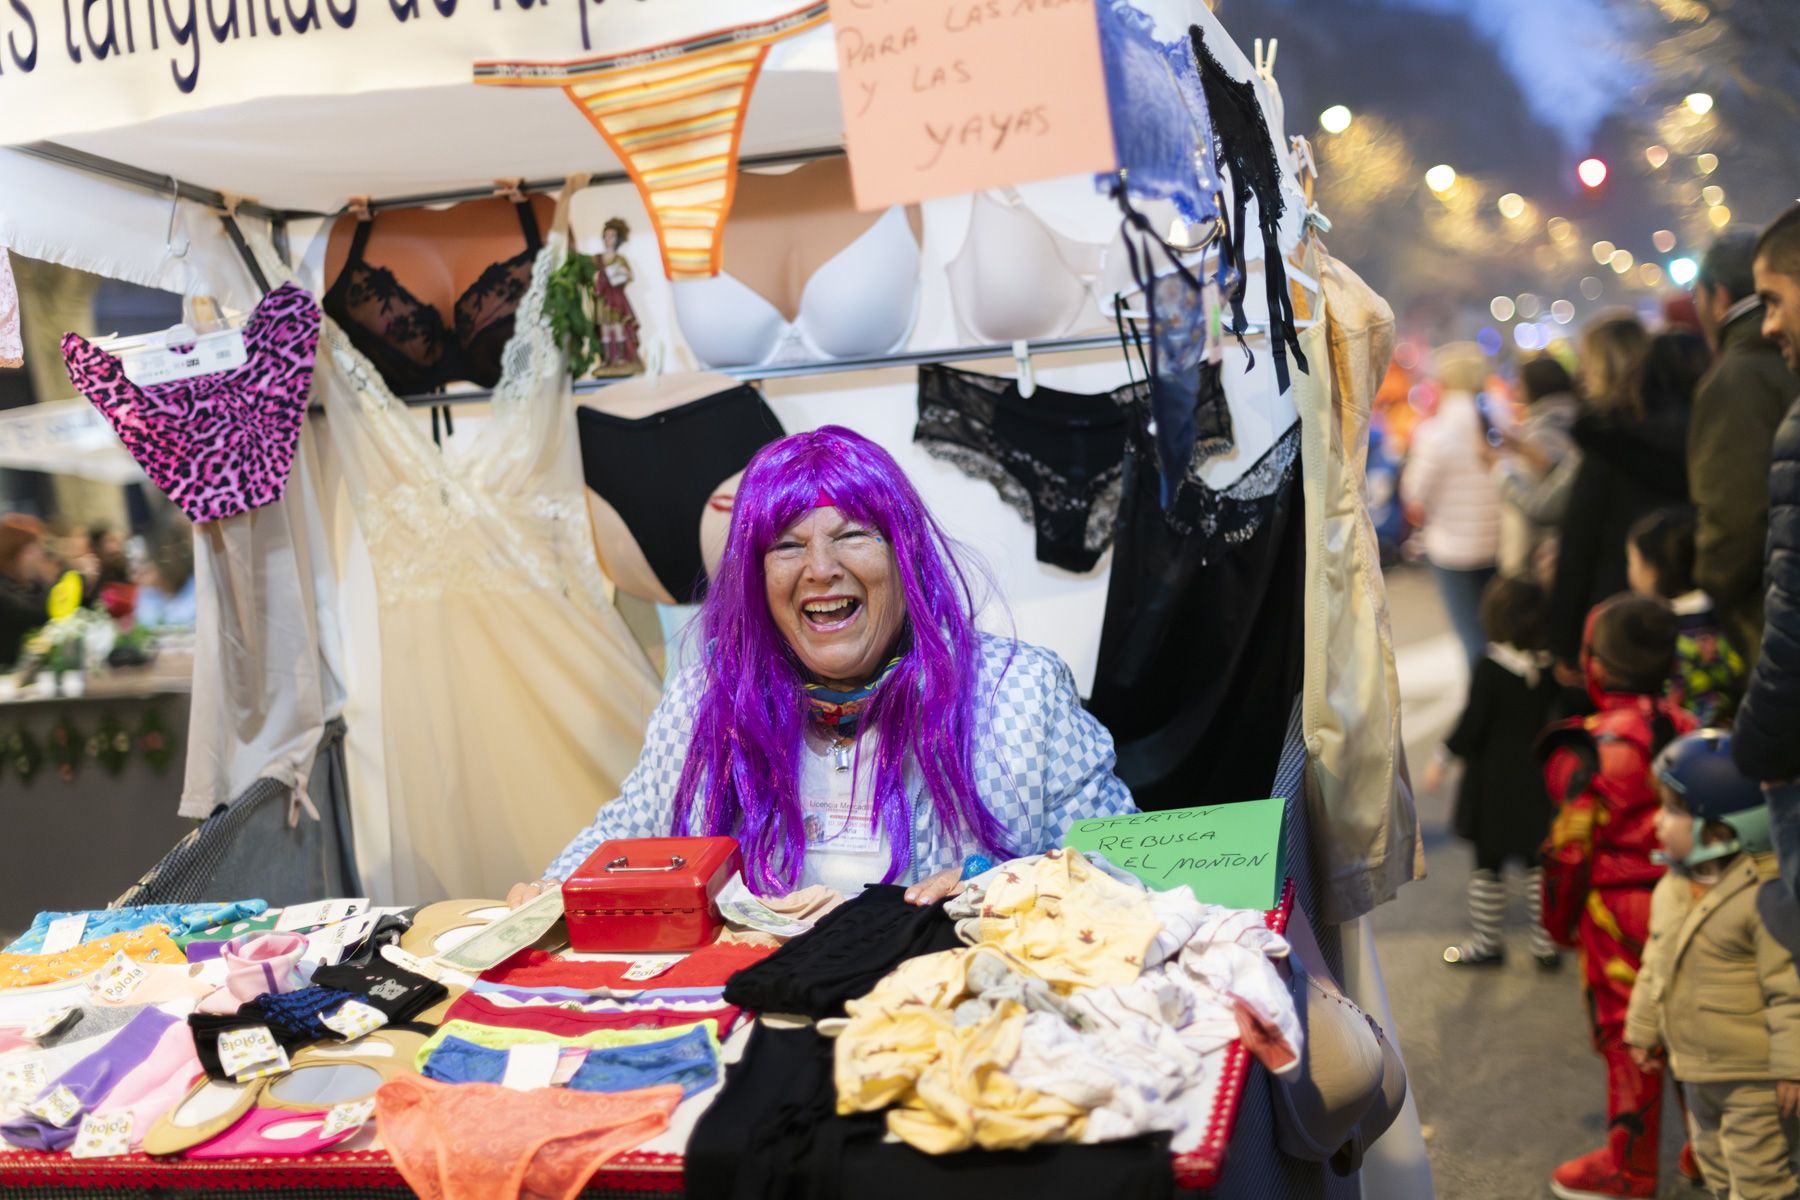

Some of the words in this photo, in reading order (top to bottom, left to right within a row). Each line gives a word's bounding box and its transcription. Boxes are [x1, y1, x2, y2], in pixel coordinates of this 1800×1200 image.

[836, 27, 918, 67] PARA
[944, 0, 1001, 33] LAS
[912, 60, 972, 93] LAS
[917, 105, 1050, 170] YAYAS
[1080, 806, 1226, 833] OFERTON
[1098, 830, 1217, 852] REBUSCA
[1123, 853, 1158, 870] EL
[1162, 851, 1270, 880] MONTON
